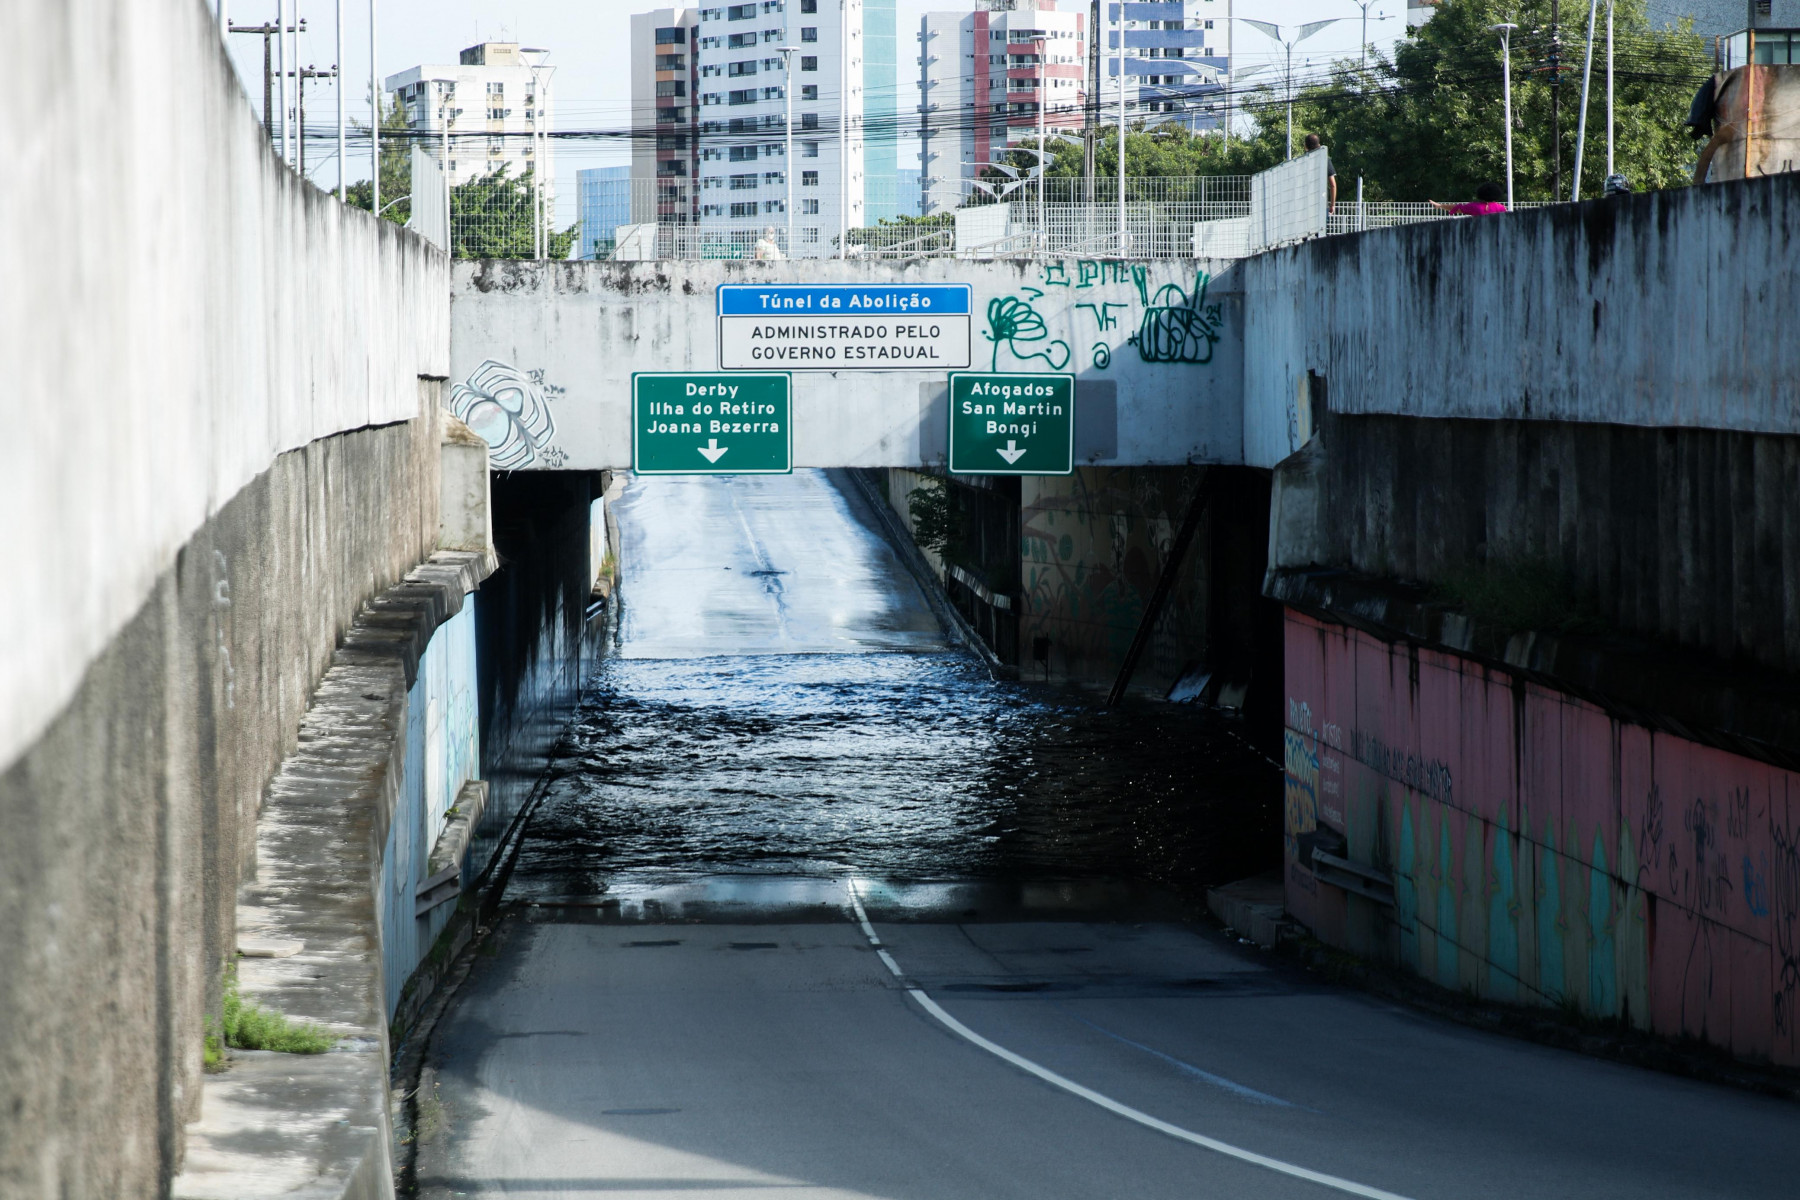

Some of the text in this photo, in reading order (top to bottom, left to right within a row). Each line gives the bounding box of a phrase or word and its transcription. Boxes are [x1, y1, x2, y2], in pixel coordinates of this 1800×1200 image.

[759, 293, 932, 311] Túnel da Abolição
[751, 325, 941, 339] ADMINISTRADO PELO
[751, 346, 940, 360] GOVERNO ESTADUAL
[686, 382, 739, 399] Derby
[970, 382, 1054, 400] Afogados
[650, 401, 775, 415] Ilha do Retiro
[962, 401, 1062, 415] San Martin
[647, 420, 779, 434] Joana Bezerra
[986, 420, 1037, 437] Bongi
